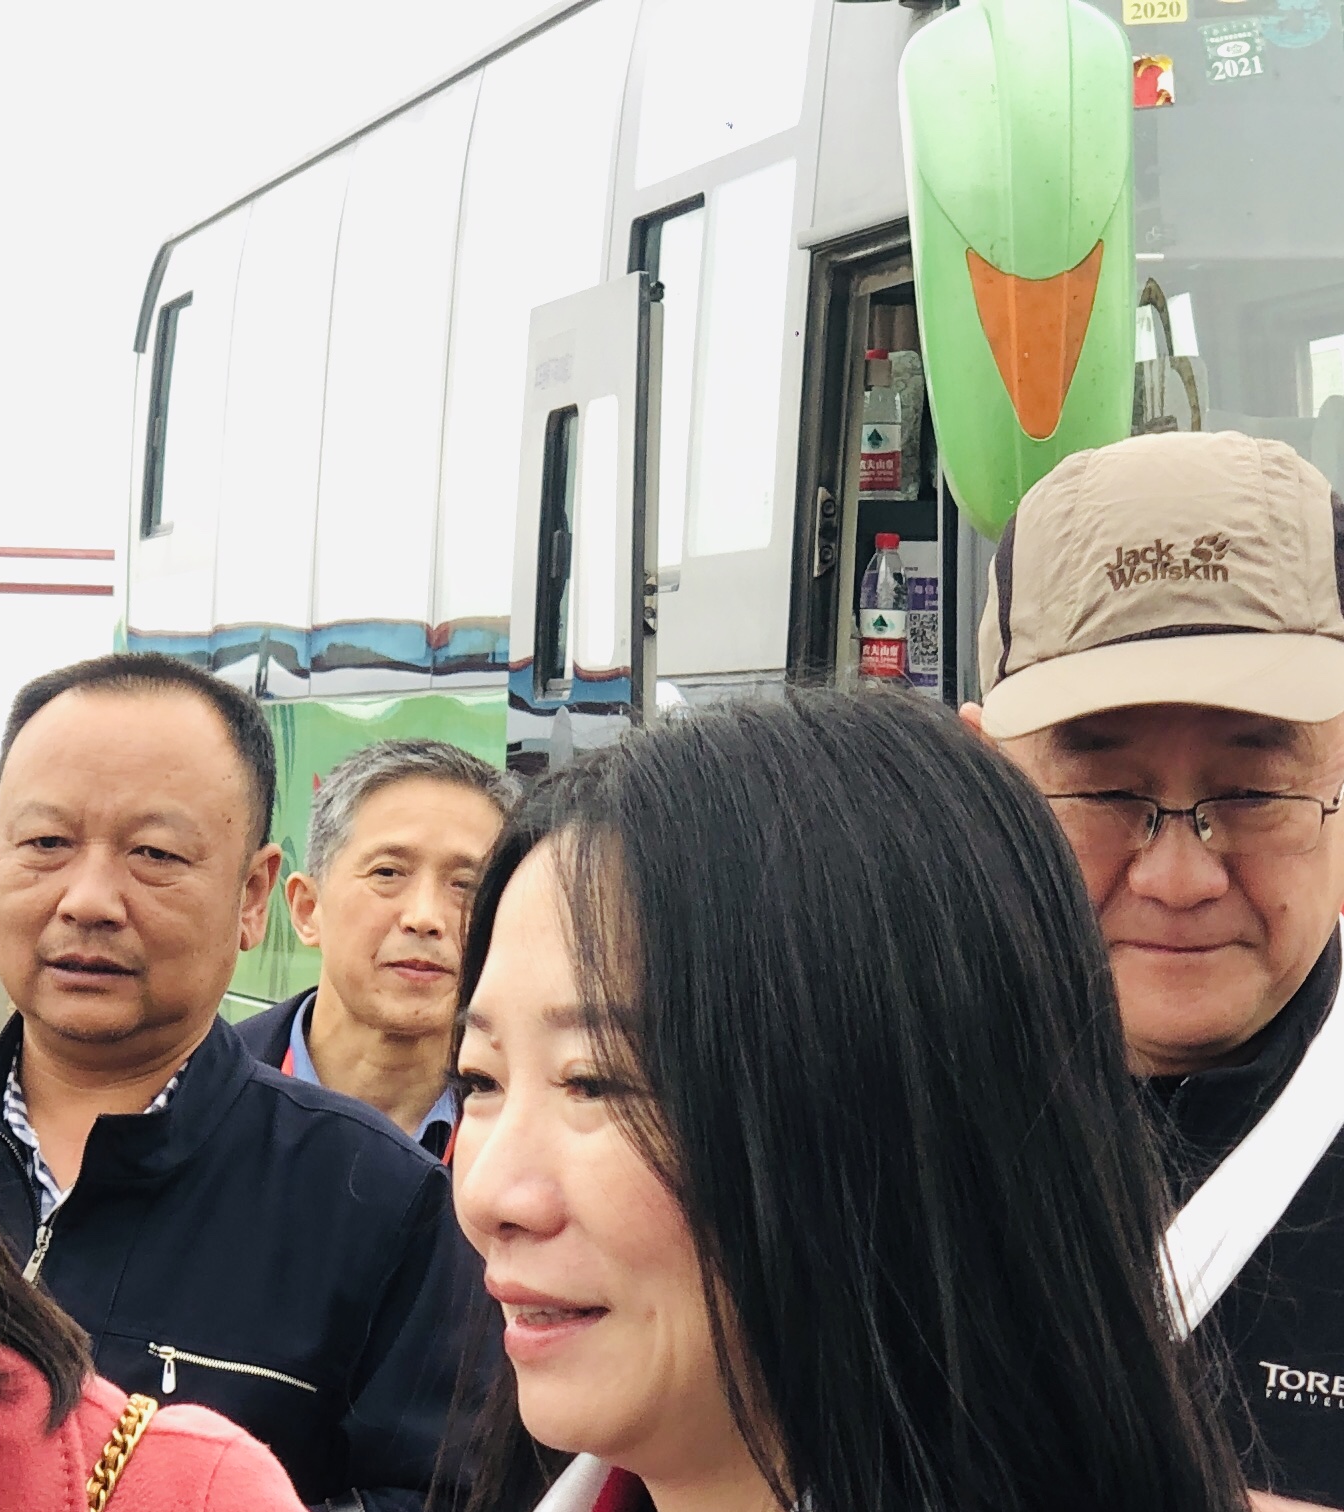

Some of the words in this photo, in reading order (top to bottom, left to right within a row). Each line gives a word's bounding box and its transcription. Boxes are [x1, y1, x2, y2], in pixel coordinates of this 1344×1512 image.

[1131, 2, 1181, 20] 2020
[1211, 55, 1264, 81] 2021
[1104, 539, 1176, 571] Jack
[1106, 558, 1229, 592] Wolfskin
